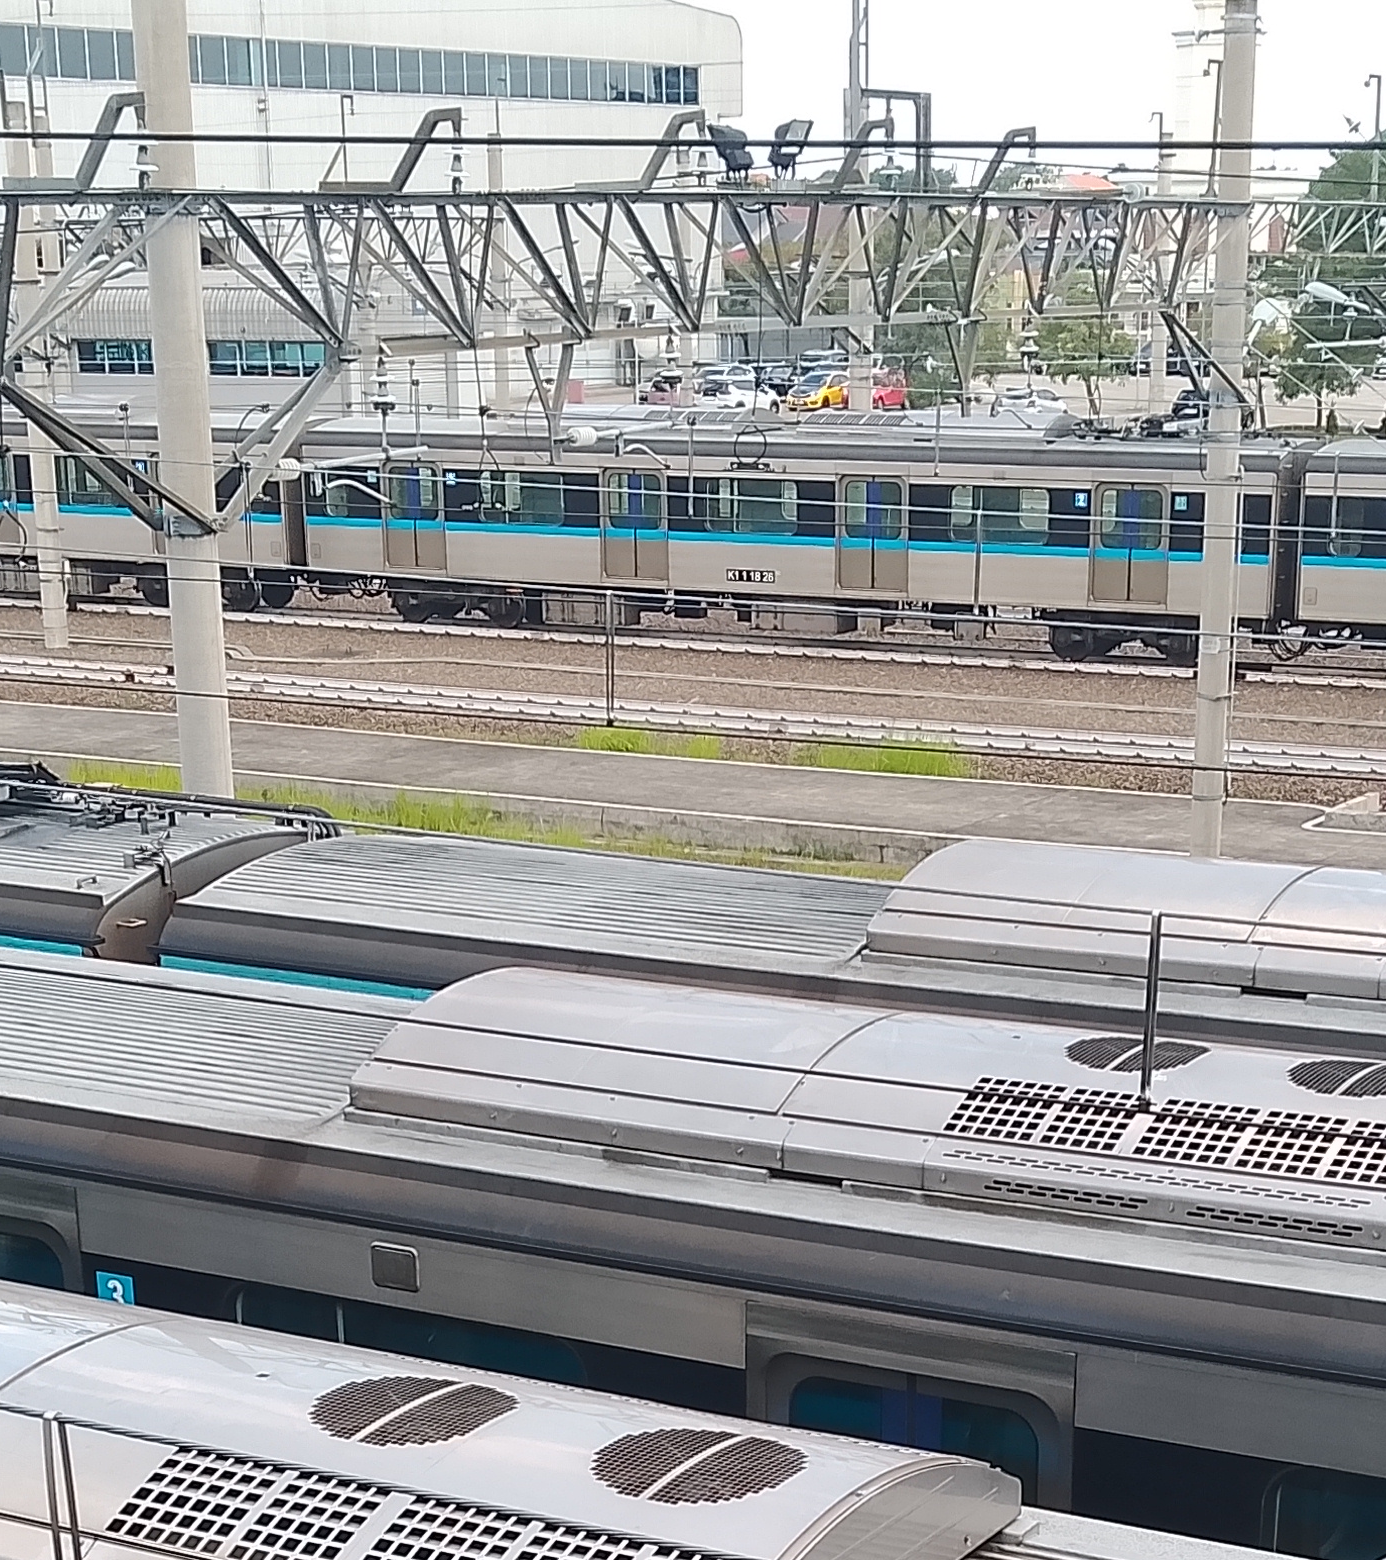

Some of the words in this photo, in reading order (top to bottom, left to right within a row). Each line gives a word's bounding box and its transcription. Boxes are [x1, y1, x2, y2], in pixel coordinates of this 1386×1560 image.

[727, 570, 739, 581] K1
[749, 571, 761, 581] 18
[762, 571, 774, 582] 26
